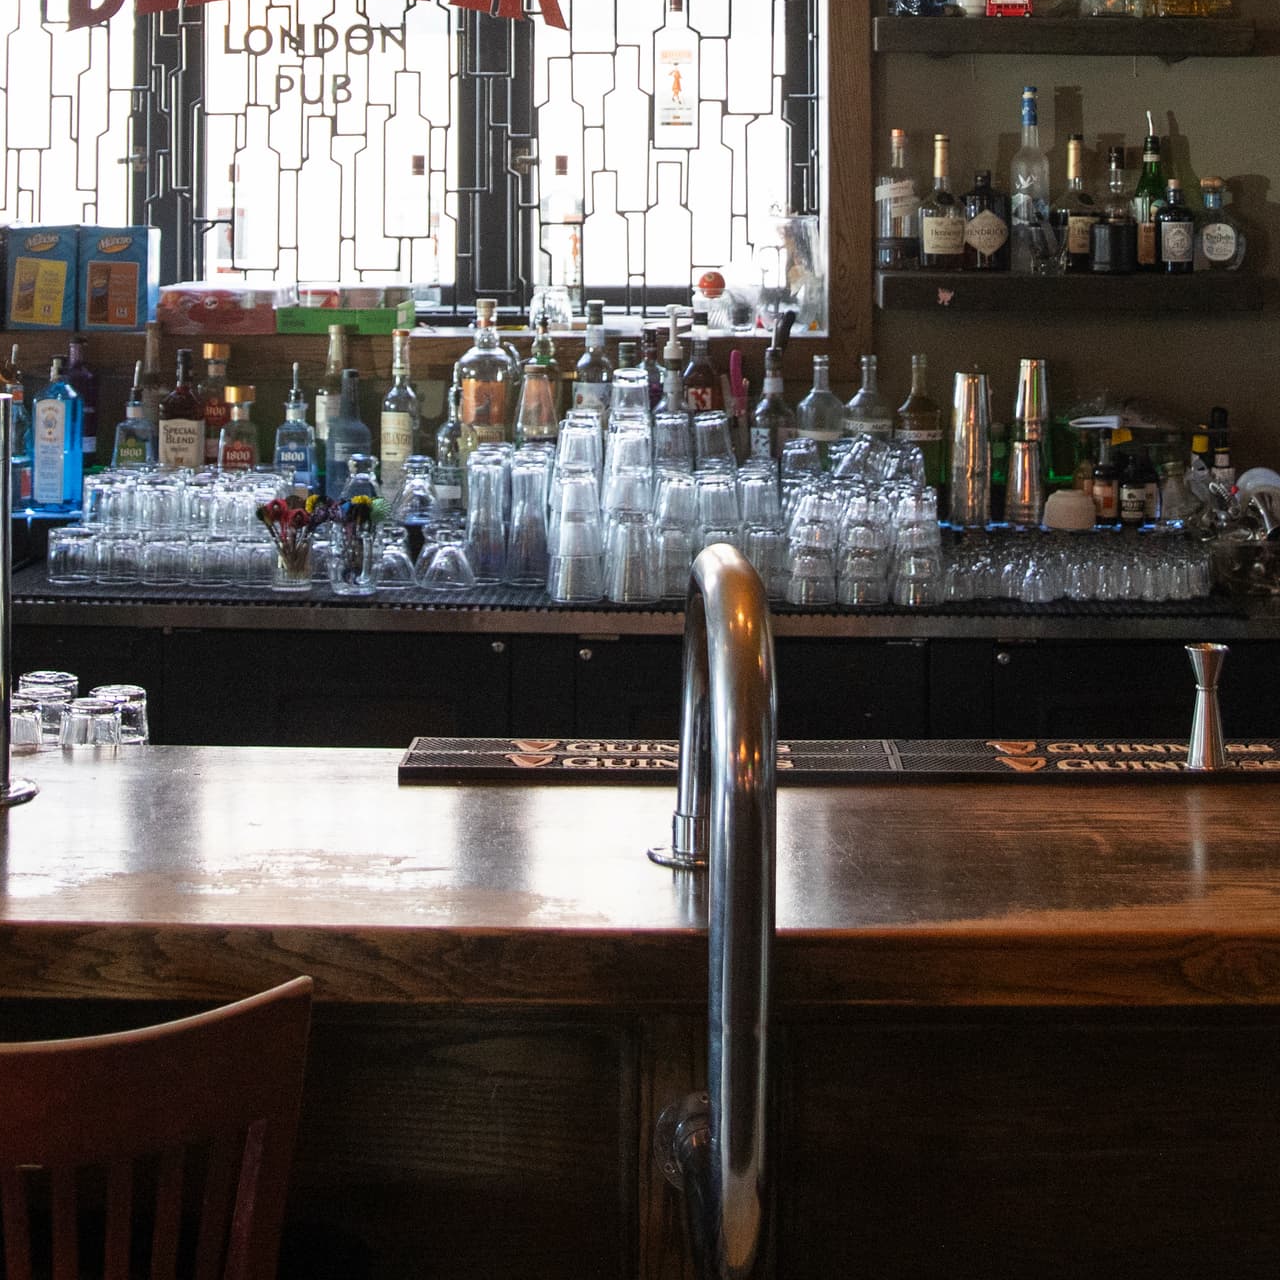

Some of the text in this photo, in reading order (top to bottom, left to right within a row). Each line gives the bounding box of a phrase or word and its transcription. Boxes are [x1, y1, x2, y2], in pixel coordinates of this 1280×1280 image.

[224, 22, 406, 56] LONDON
[275, 74, 352, 105] PUB
[162, 424, 197, 437] SPECIAL
[165, 434, 195, 446] BLEND
[120, 447, 142, 458] 1800
[226, 450, 251, 462] 1800
[280, 451, 305, 462] 1800
